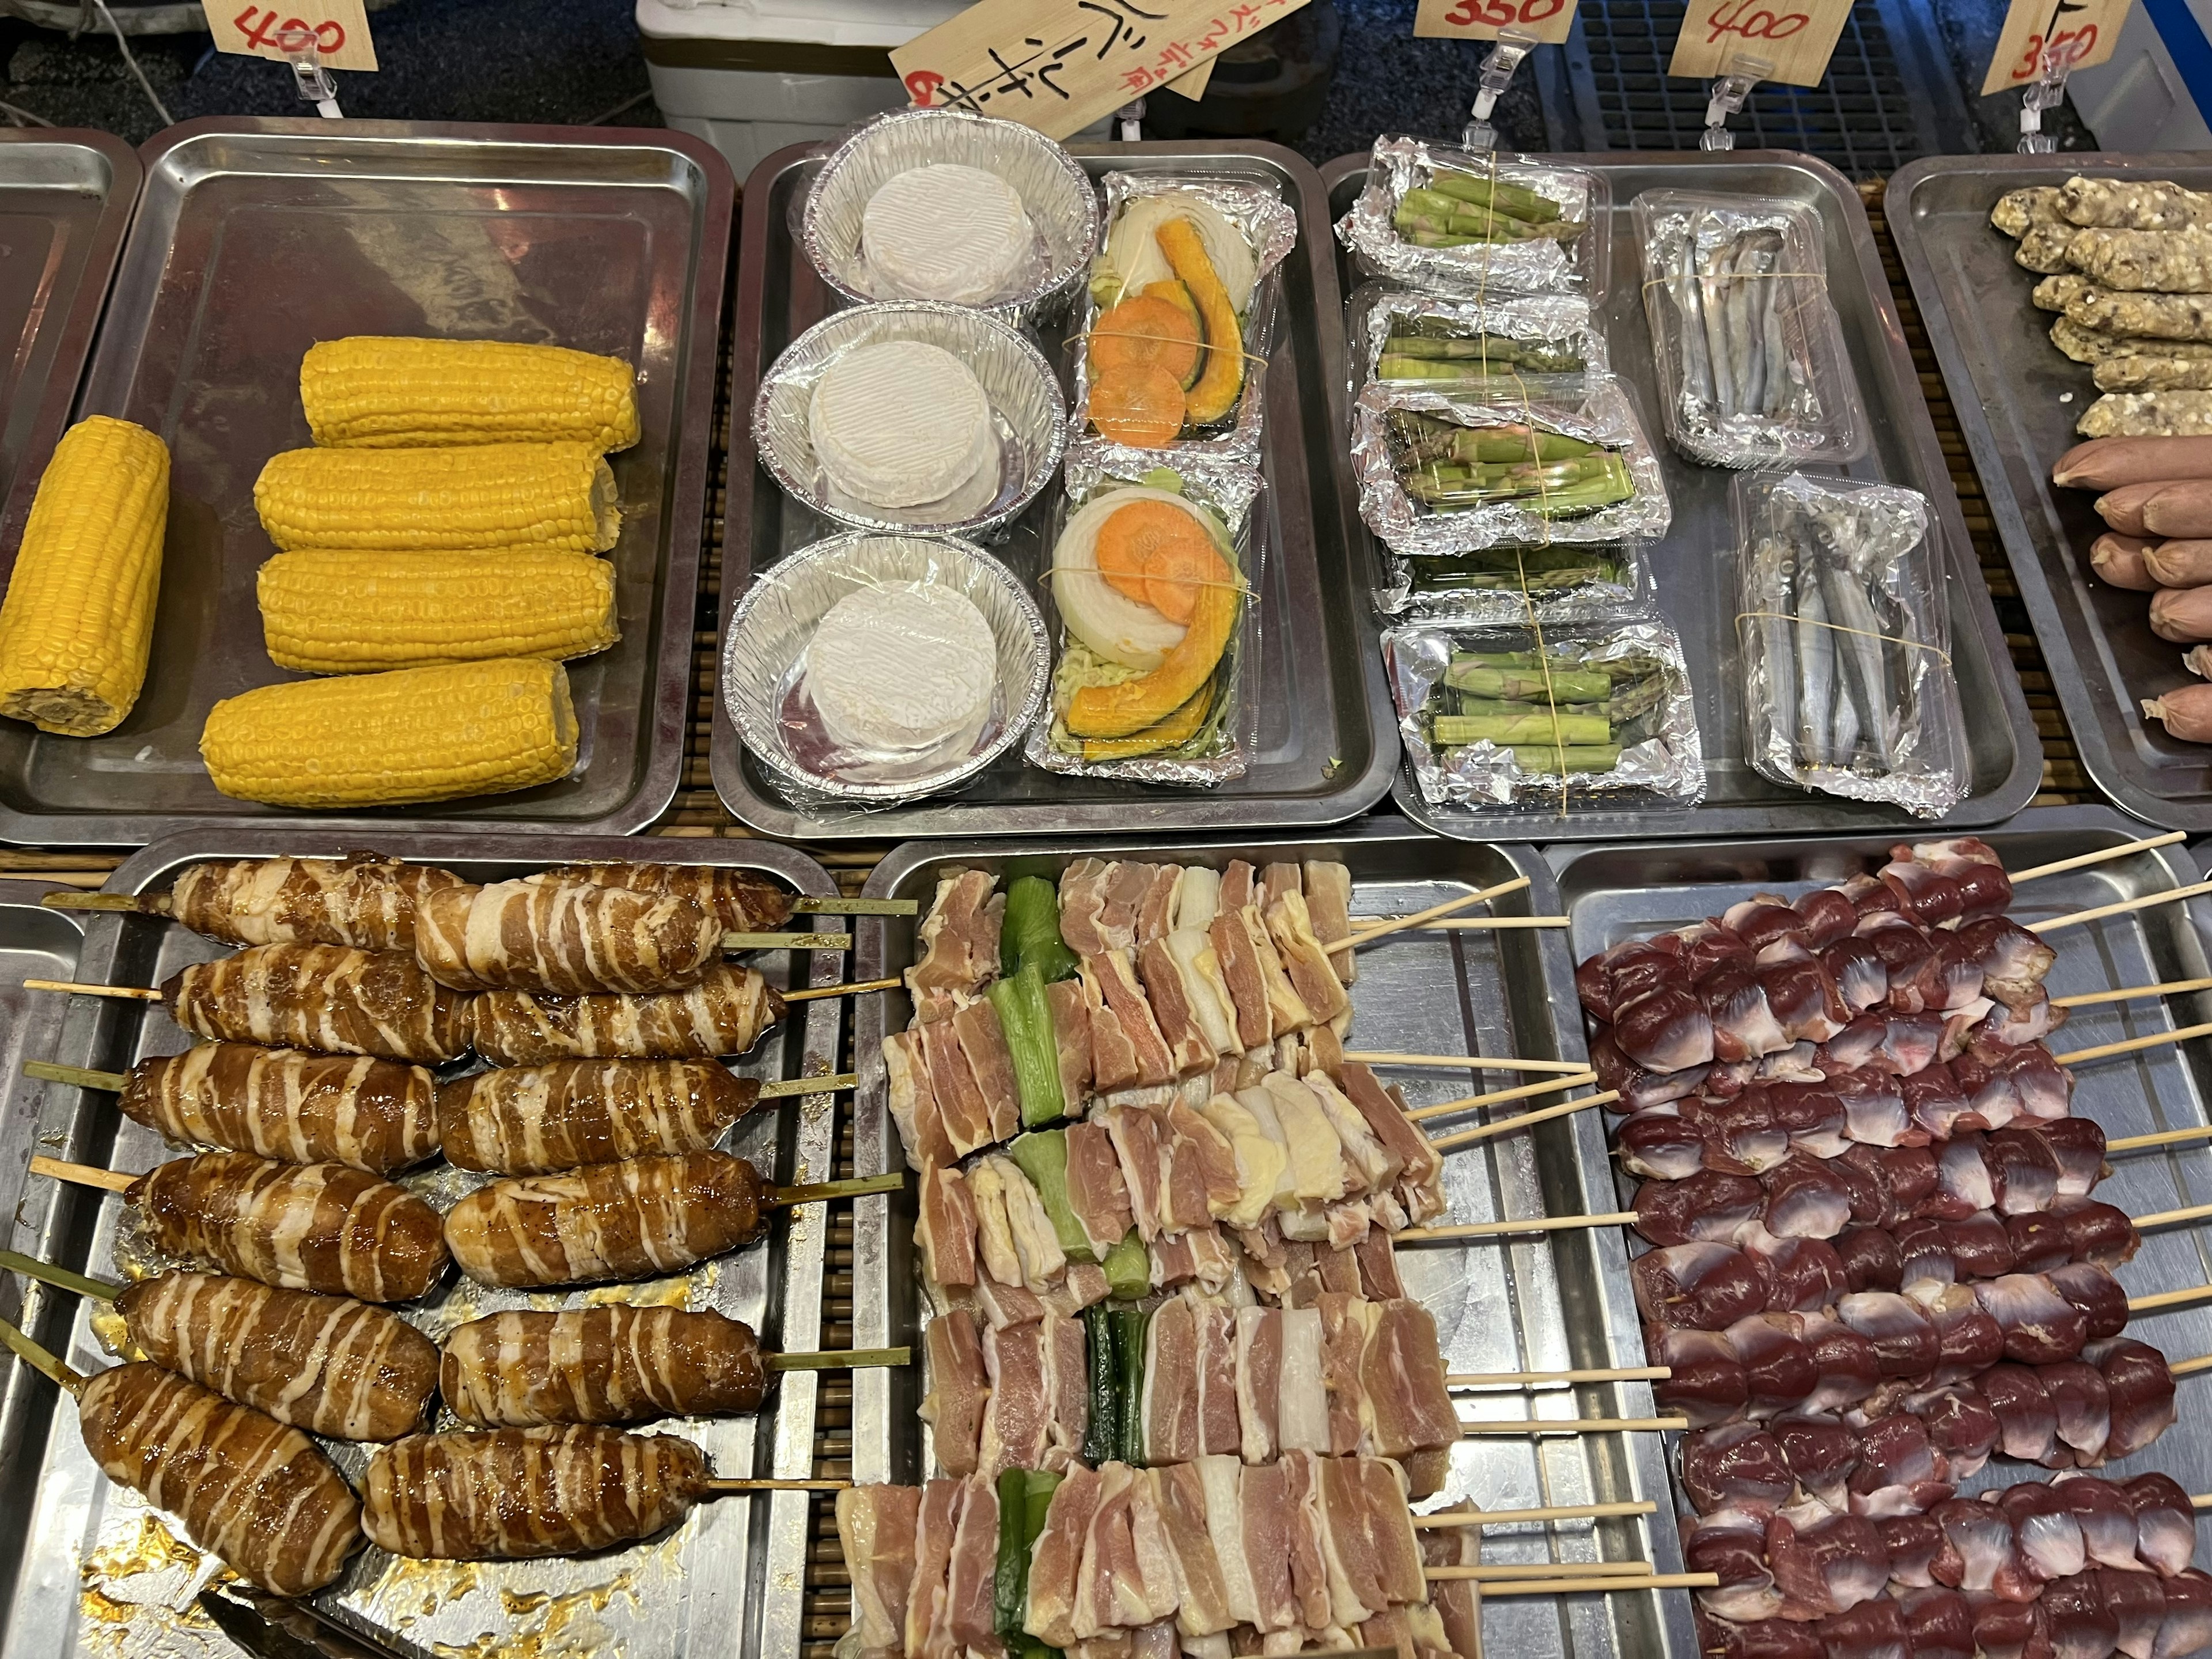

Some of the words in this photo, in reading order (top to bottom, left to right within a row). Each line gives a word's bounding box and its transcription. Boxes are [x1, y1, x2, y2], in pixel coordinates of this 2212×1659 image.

[233, 6, 345, 54] 400
[1444, 0, 1565, 26] 350
[1706, 0, 1810, 43] 400
[2012, 24, 2098, 79] 350
